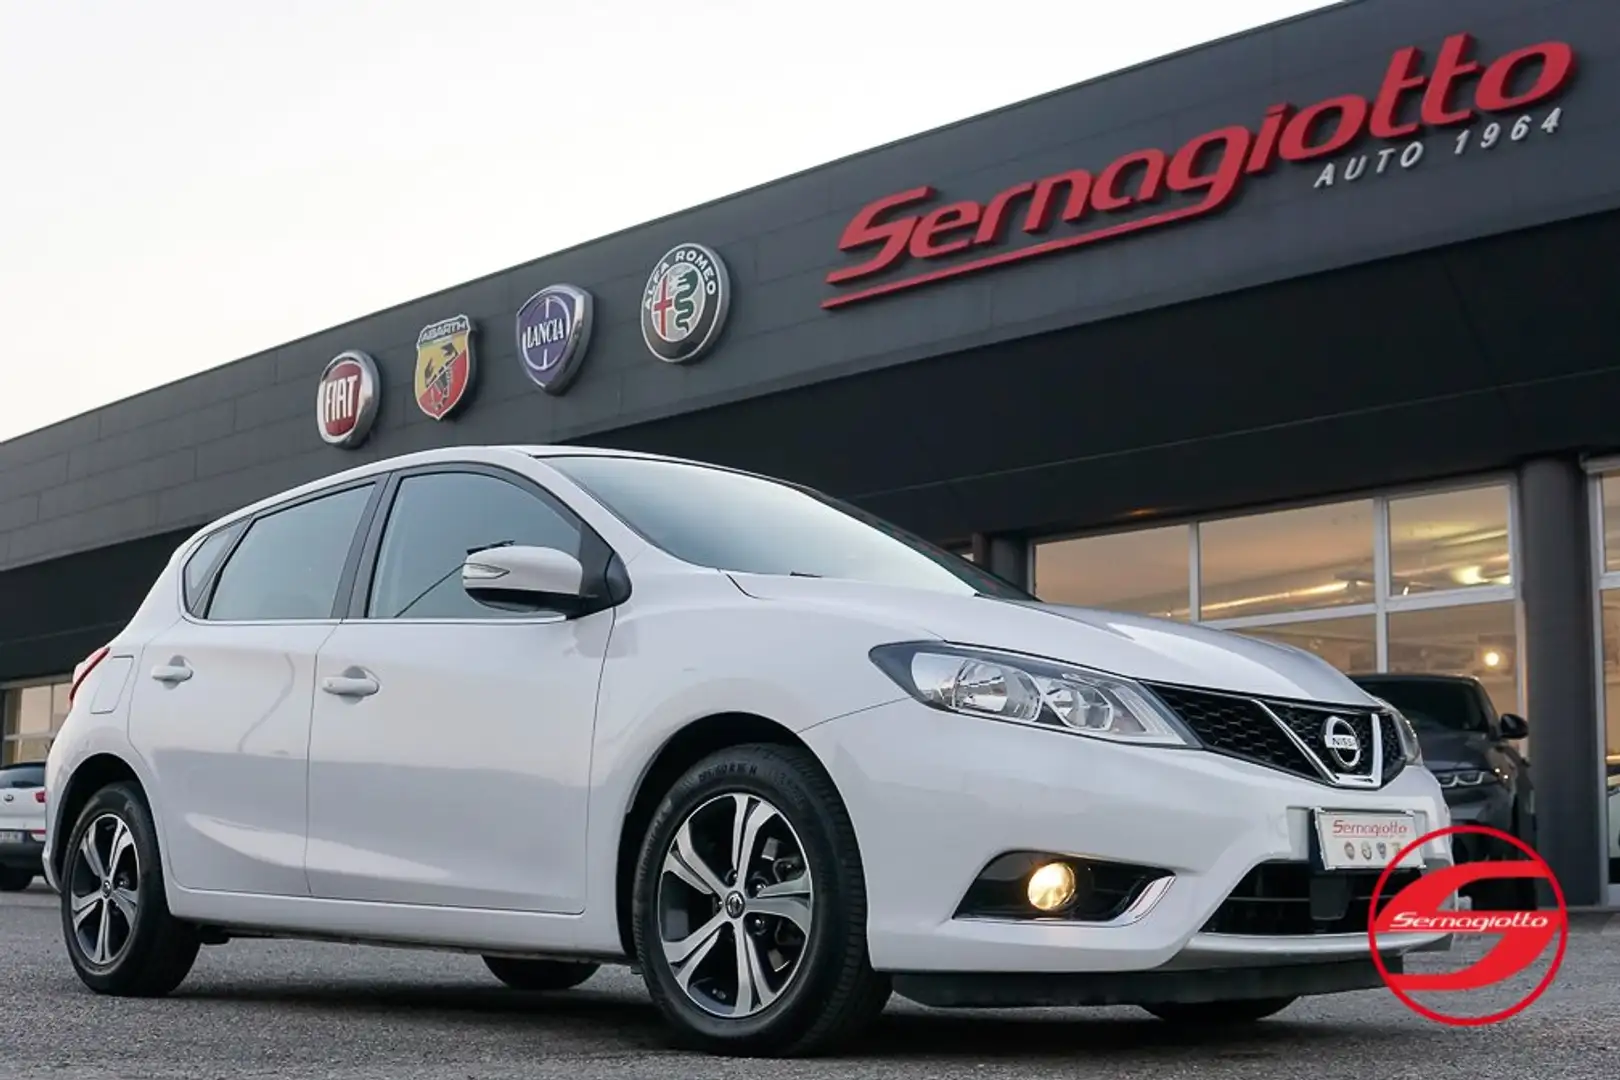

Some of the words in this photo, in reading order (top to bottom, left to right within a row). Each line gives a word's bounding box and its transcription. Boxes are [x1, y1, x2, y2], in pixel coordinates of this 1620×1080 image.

[825, 32, 1577, 284] Sernagiotto
[1313, 141, 1424, 188] AUTO
[1454, 107, 1562, 155] 1964
[675, 250, 716, 295] ROMEO
[421, 321, 467, 342] ABARTH
[527, 318, 564, 348] LANCIA
[325, 375, 358, 423] FIAT
[1332, 819, 1408, 836] Sernagiotto
